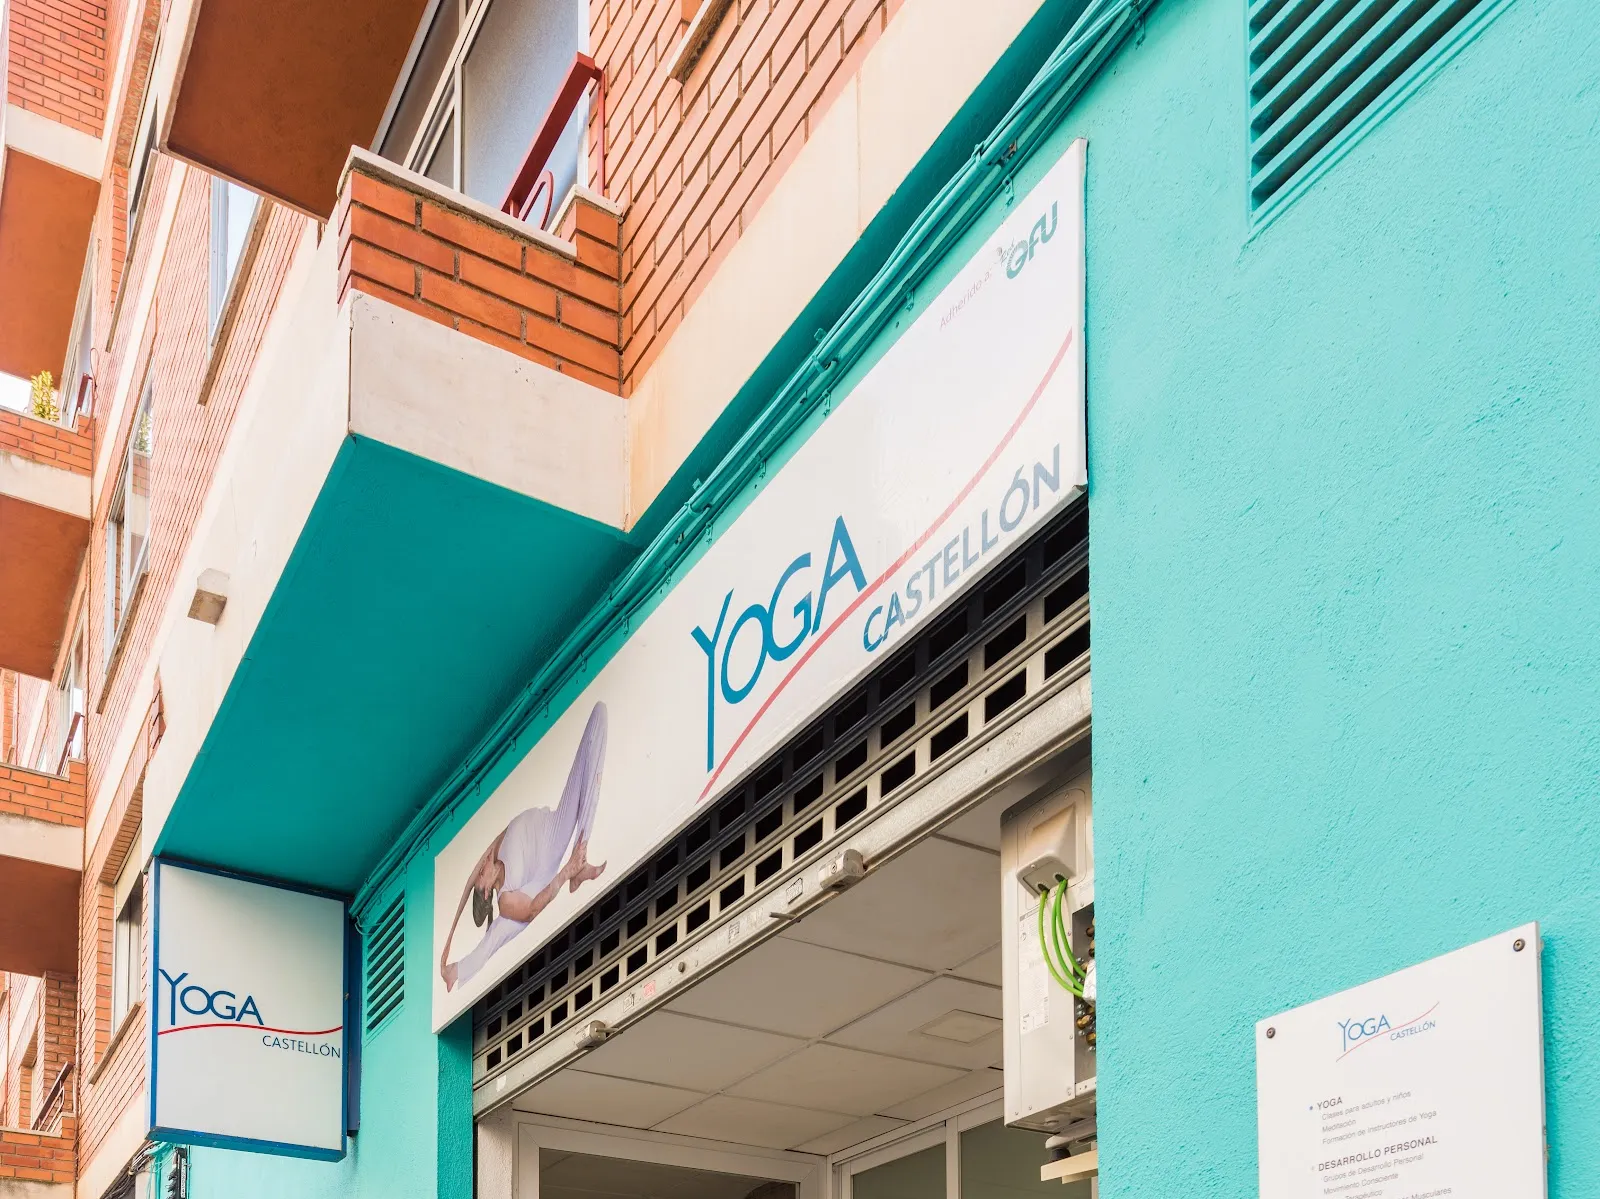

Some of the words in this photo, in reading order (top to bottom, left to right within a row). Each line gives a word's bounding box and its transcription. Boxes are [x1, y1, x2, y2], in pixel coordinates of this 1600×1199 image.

[940, 280, 982, 331] Adherido
[862, 443, 1060, 652] CASTELLÓN
[690, 515, 868, 773] YOGA
[158, 968, 265, 1026] YOGA
[262, 1034, 341, 1059] CASTELLÓN
[1337, 1014, 1391, 1052] YOGA
[1389, 1019, 1436, 1041] CASTELLÓN
[1317, 1096, 1343, 1110] YOGA
[1322, 1110, 1343, 1121] Clases
[1345, 1106, 1359, 1116] para
[1361, 1098, 1385, 1110] adultos
[1392, 1090, 1411, 1101] niños
[1322, 1119, 1356, 1133] Meditación
[1322, 1132, 1356, 1145] Formación
[1357, 1128, 1366, 1136] de
[1367, 1118, 1407, 1133] Instructores
[1408, 1114, 1417, 1123] de
[1419, 1110, 1437, 1122] Yoga
[1318, 1148, 1381, 1172] DESARROLLO
[1384, 1135, 1438, 1155] PERSONAL
[1348, 1168, 1356, 1177] de
[1357, 1161, 1391, 1175] Desarrollo
[1393, 1153, 1424, 1166] Personal
[1323, 1182, 1360, 1195] Movimiento
